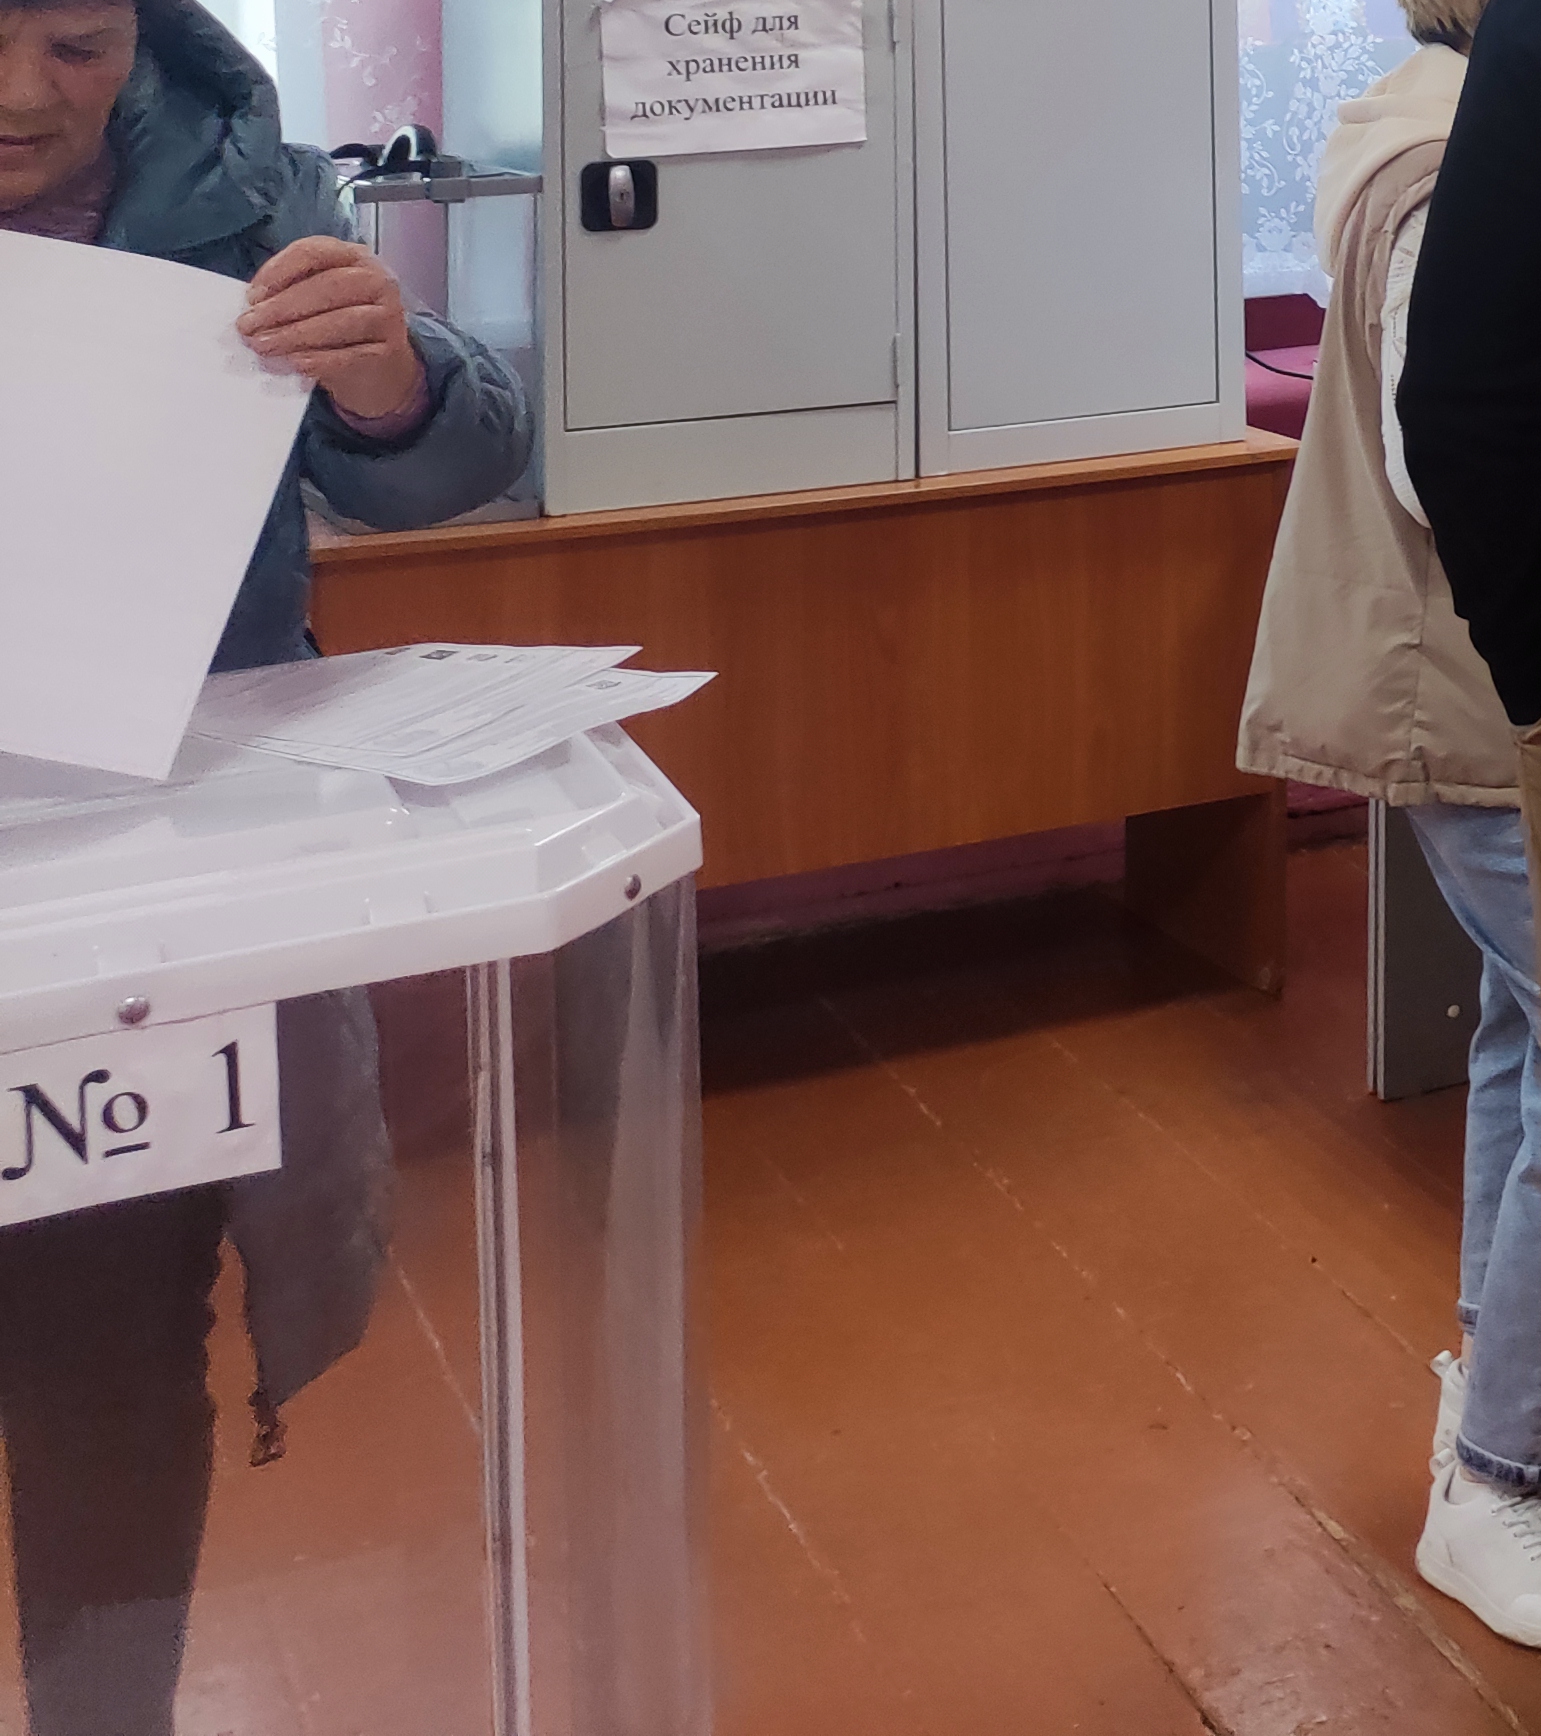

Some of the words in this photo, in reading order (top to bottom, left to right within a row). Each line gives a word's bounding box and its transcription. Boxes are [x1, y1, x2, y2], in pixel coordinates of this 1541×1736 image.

[663, 11, 743, 40] Сейф
[751, 14, 800, 34] для
[666, 52, 801, 82] хранения
[630, 89, 839, 121] документации
[210, 1039, 258, 1135] 1
